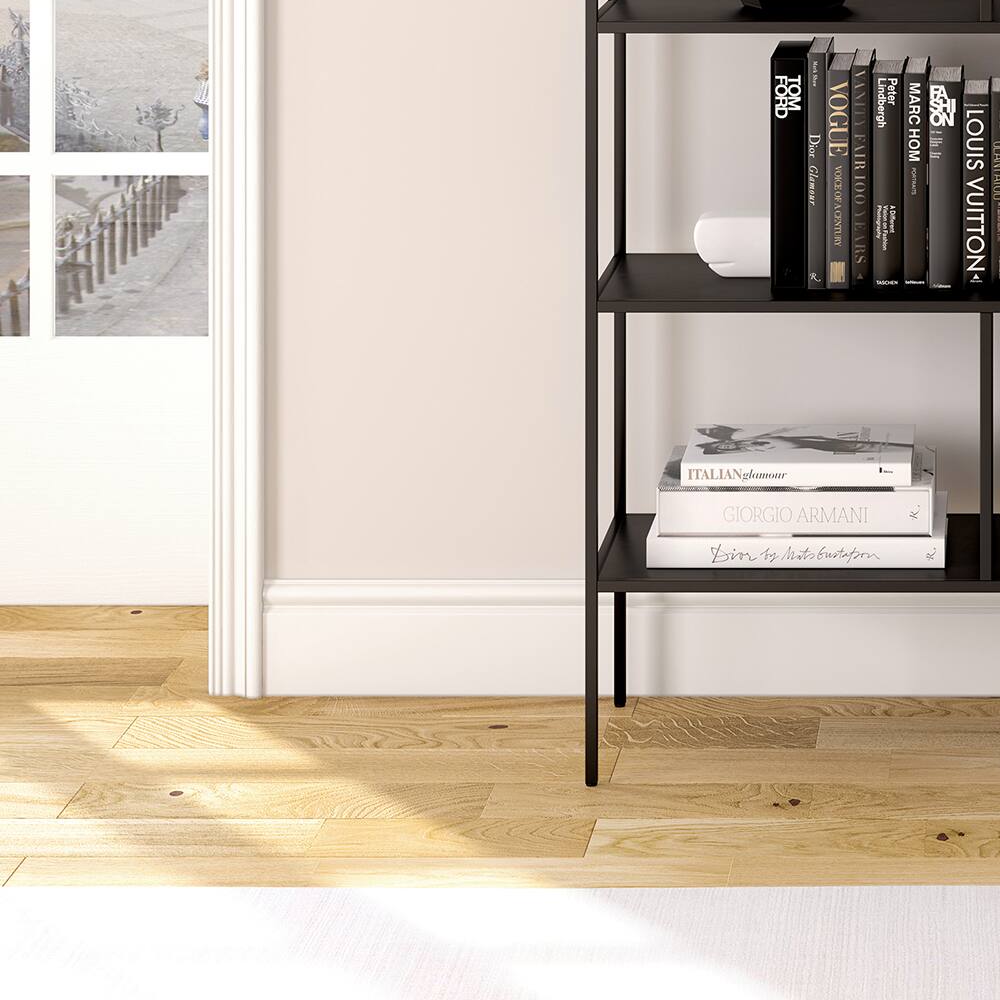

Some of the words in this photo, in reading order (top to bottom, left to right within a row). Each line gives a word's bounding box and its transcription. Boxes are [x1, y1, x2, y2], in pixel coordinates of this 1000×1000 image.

[775, 75, 788, 118] FORD
[788, 75, 801, 111] TOM
[854, 69, 866, 129] VANITY
[876, 78, 887, 128] Lindbergh
[887, 78, 898, 106] Peter
[908, 82, 921, 125] MARC
[828, 80, 848, 156] VOGUE
[809, 134, 820, 158] Dior
[855, 134, 866, 170] FAIR
[908, 129, 921, 162] HOM
[966, 110, 984, 170] LOUIS
[809, 165, 819, 206] Glamour
[834, 166, 842, 190] VOICE
[834, 191, 842, 202] OF
[834, 211, 842, 247] CENTURY
[855, 211, 866, 264] YEARS
[966, 177, 986, 271] VUITTON
[722, 506, 792, 524] GIORGIO
[797, 506, 868, 524] ARMANI
[711, 544, 758, 563] Dior
[760, 547, 778, 563] by
